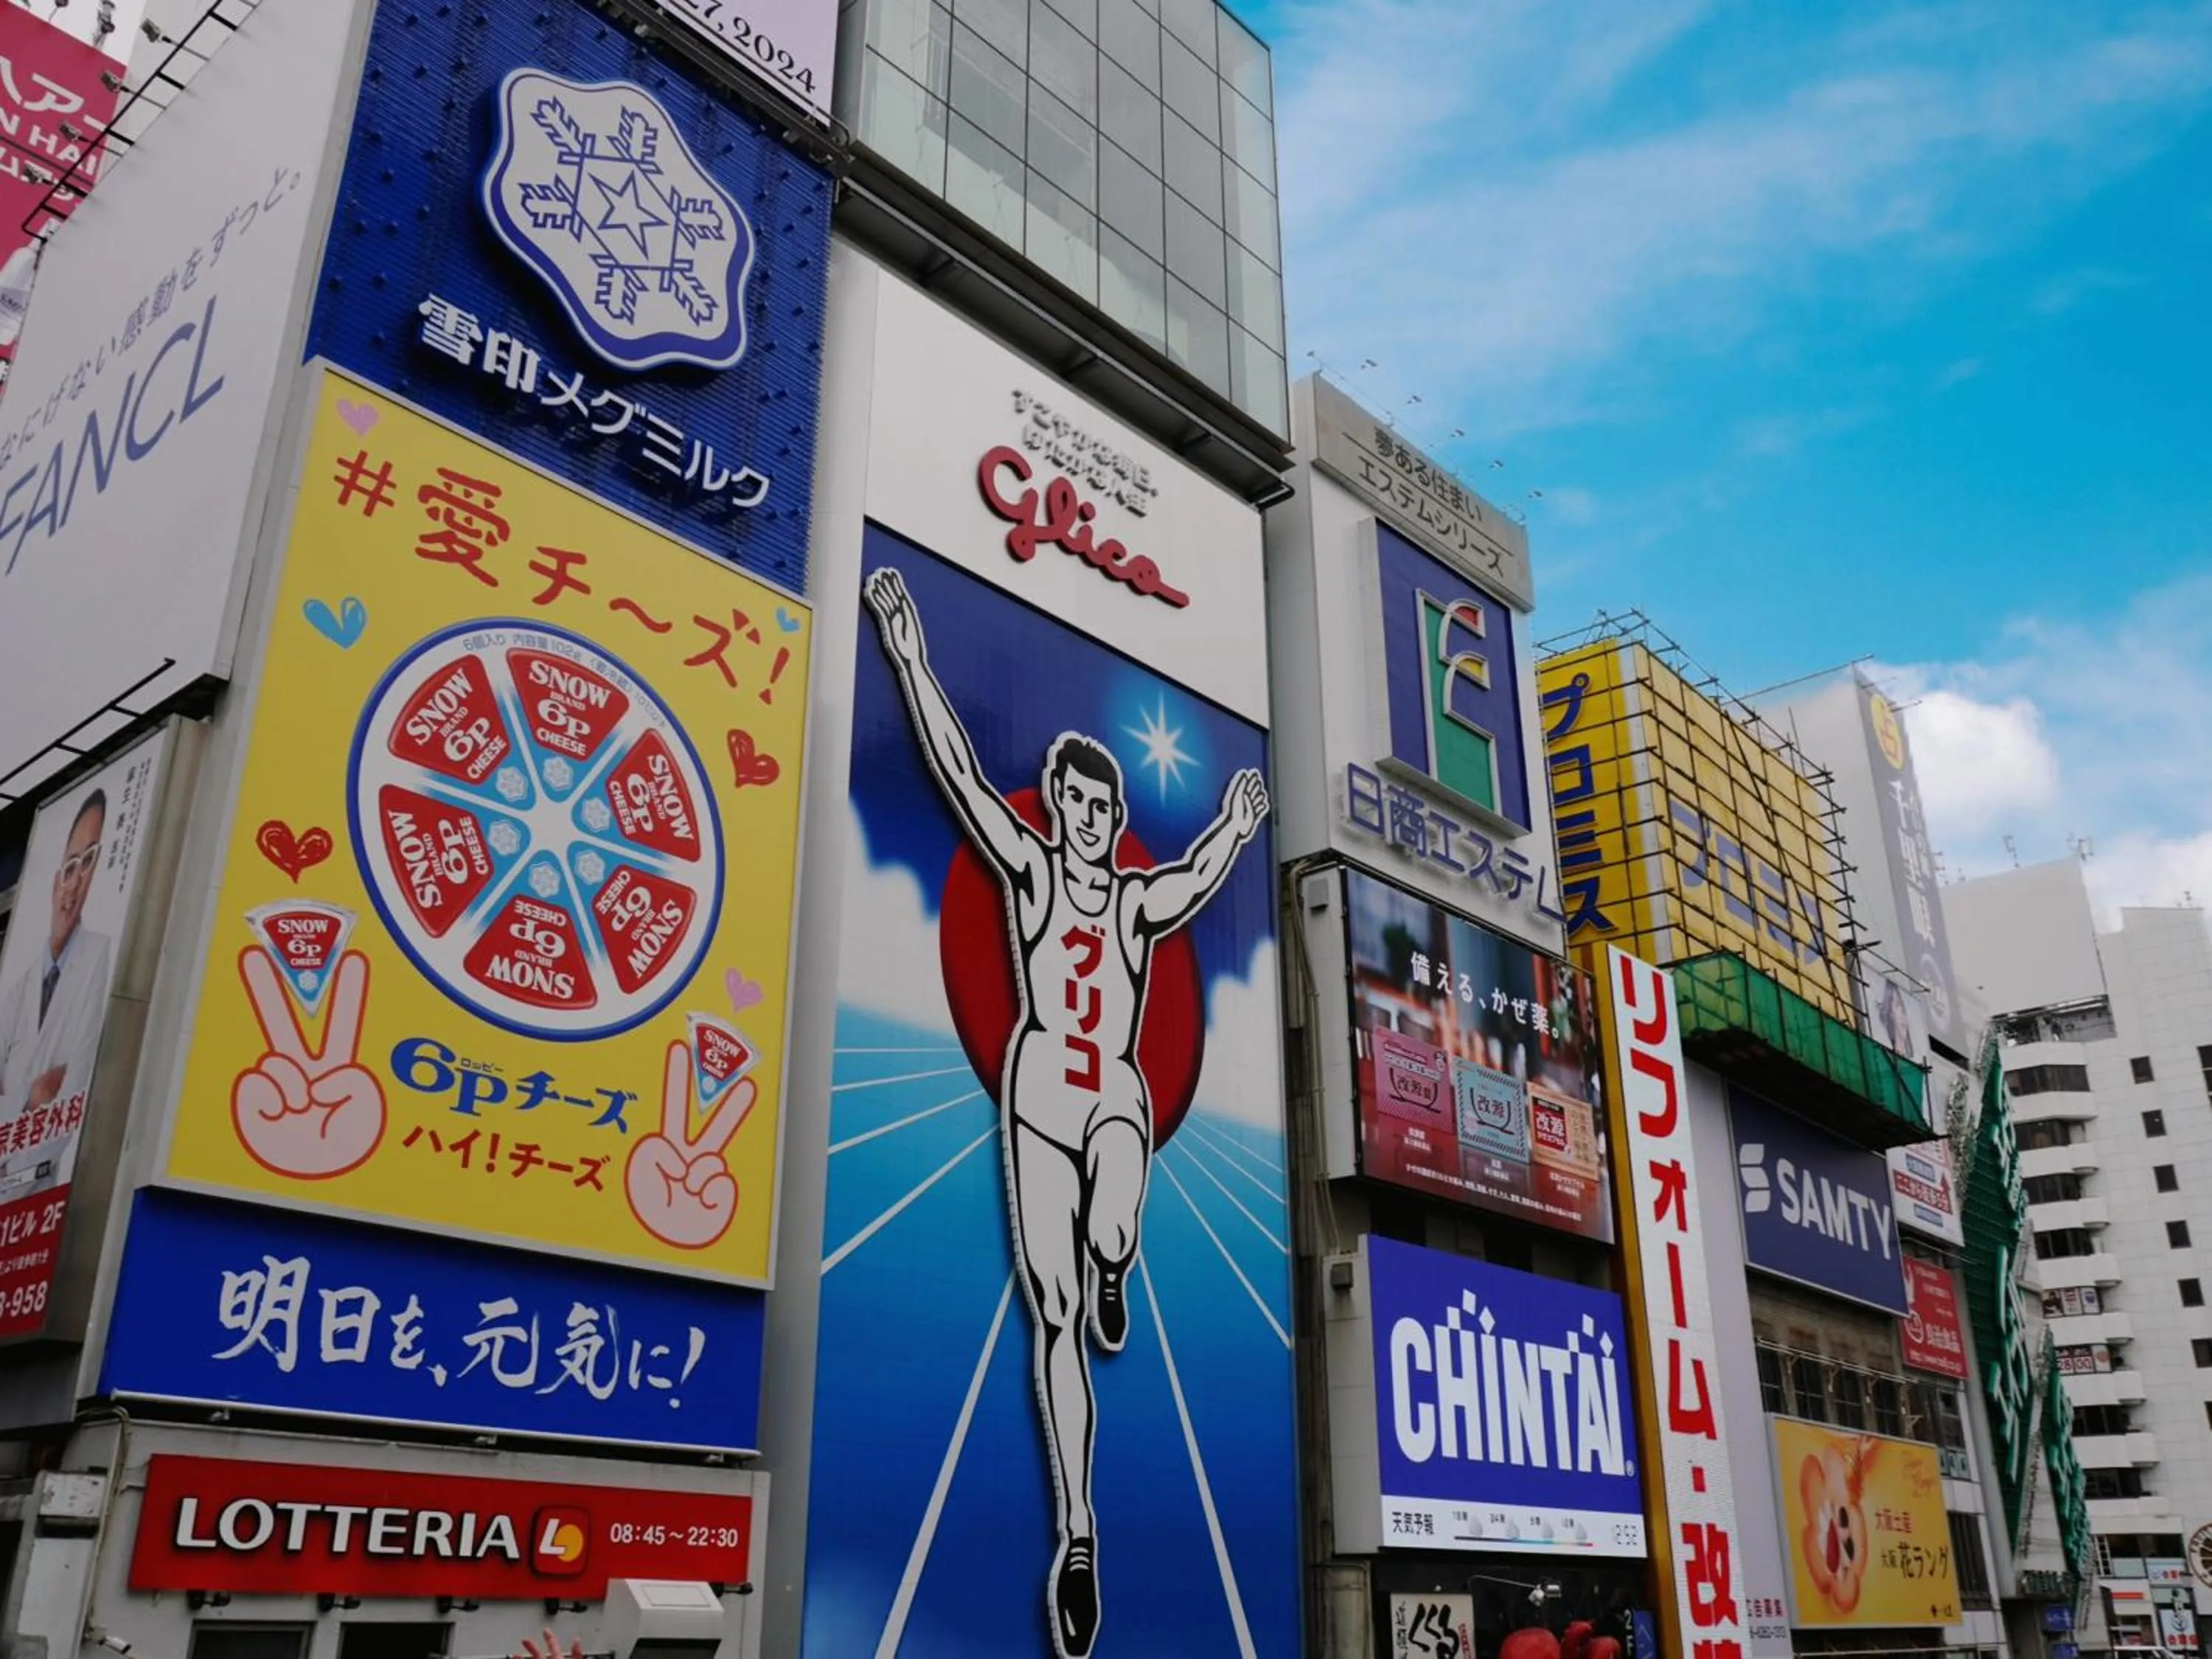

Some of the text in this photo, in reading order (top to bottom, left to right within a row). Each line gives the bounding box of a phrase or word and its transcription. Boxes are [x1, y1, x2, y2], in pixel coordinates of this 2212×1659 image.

[734, 16, 816, 94] 2024
[418, 293, 770, 508] 雪印メグミルク
[0, 295, 225, 577] FANCL
[1372, 427, 1483, 523] 夢ある住まい
[977, 445, 1190, 609] Glico
[1358, 455, 1505, 579] エステムシリーズ
[406, 669, 473, 745] SNOW
[529, 661, 611, 709] SNOW
[550, 692, 586, 711] BRAND
[439, 706, 469, 737] BRAND
[536, 727, 586, 756] CHEESE
[468, 736, 507, 780] CHEESE
[608, 781, 632, 836] CHEESE
[647, 782, 665, 821] BRAND
[648, 754, 695, 841] SNOW
[1542, 672, 1618, 936] プロミス
[389, 810, 443, 911] SNOW
[423, 832, 444, 876] BRAND
[460, 816, 490, 877] CHEESE
[515, 900, 566, 928] CHEESE
[596, 871, 631, 914] CHEESE
[278, 919, 329, 934] SNOW
[630, 908, 655, 941] BRAND
[630, 898, 684, 978] SNOW
[487, 956, 575, 998] SNOW
[515, 950, 552, 967] BRAND
[1060, 925, 1106, 1093] グリコ
[1410, 951, 1559, 1040] 備える、かぜ薬。
[461, 1057, 504, 1074] ロッピー
[703, 1029, 741, 1057] SNOW
[40, 1200, 66, 1235] 2F
[1775, 1158, 1892, 1261] SAMTY
[175, 1496, 521, 1562] LOTTERIA
[1392, 1511, 1435, 1537] 天気予報
